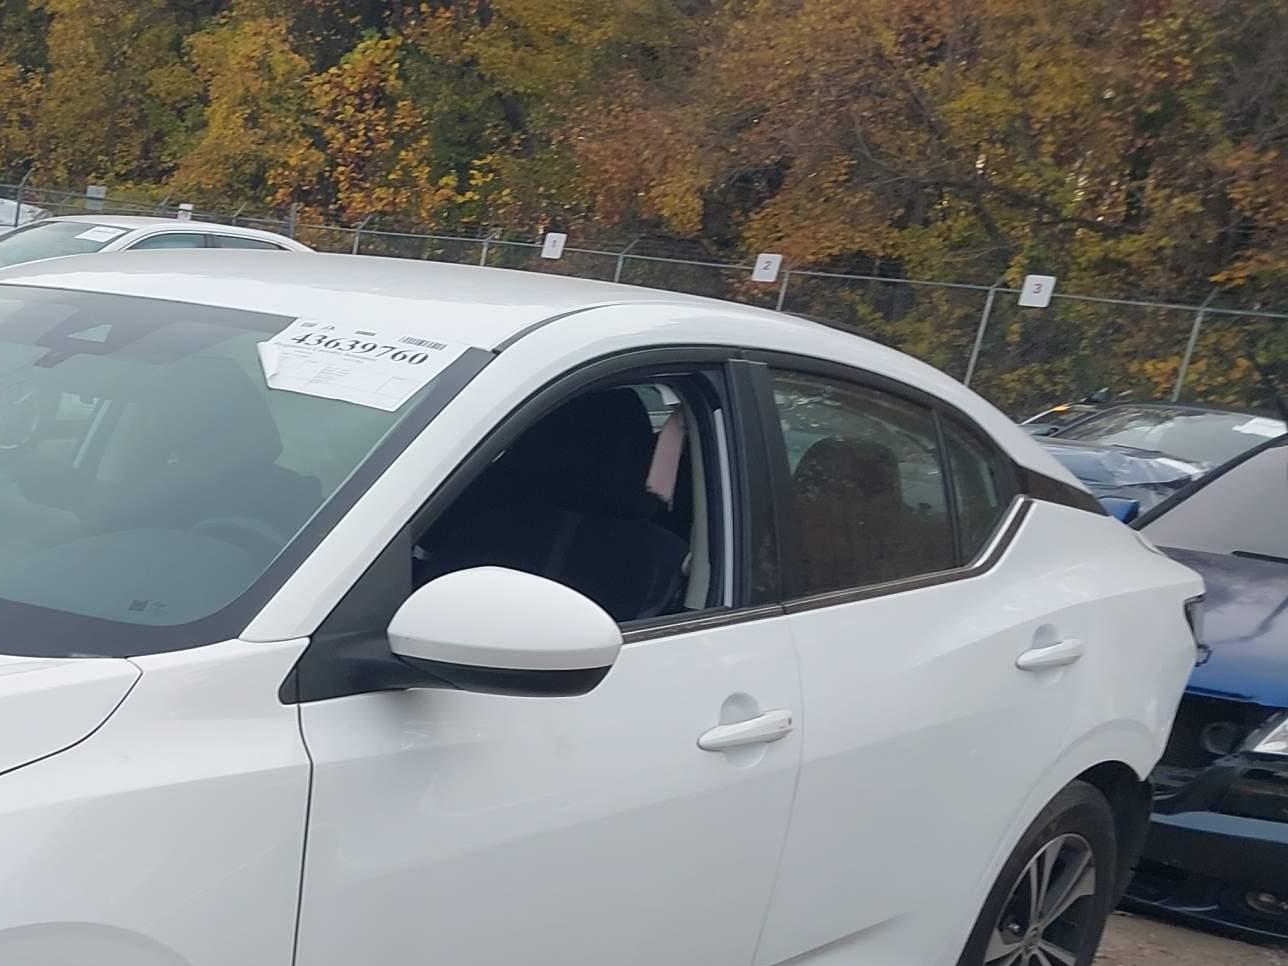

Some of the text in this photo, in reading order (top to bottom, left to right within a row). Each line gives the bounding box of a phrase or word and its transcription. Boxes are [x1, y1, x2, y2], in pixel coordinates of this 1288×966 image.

[763, 260, 773, 271] 2
[1033, 283, 1043, 294] 3
[291, 332, 429, 365] 43639760
